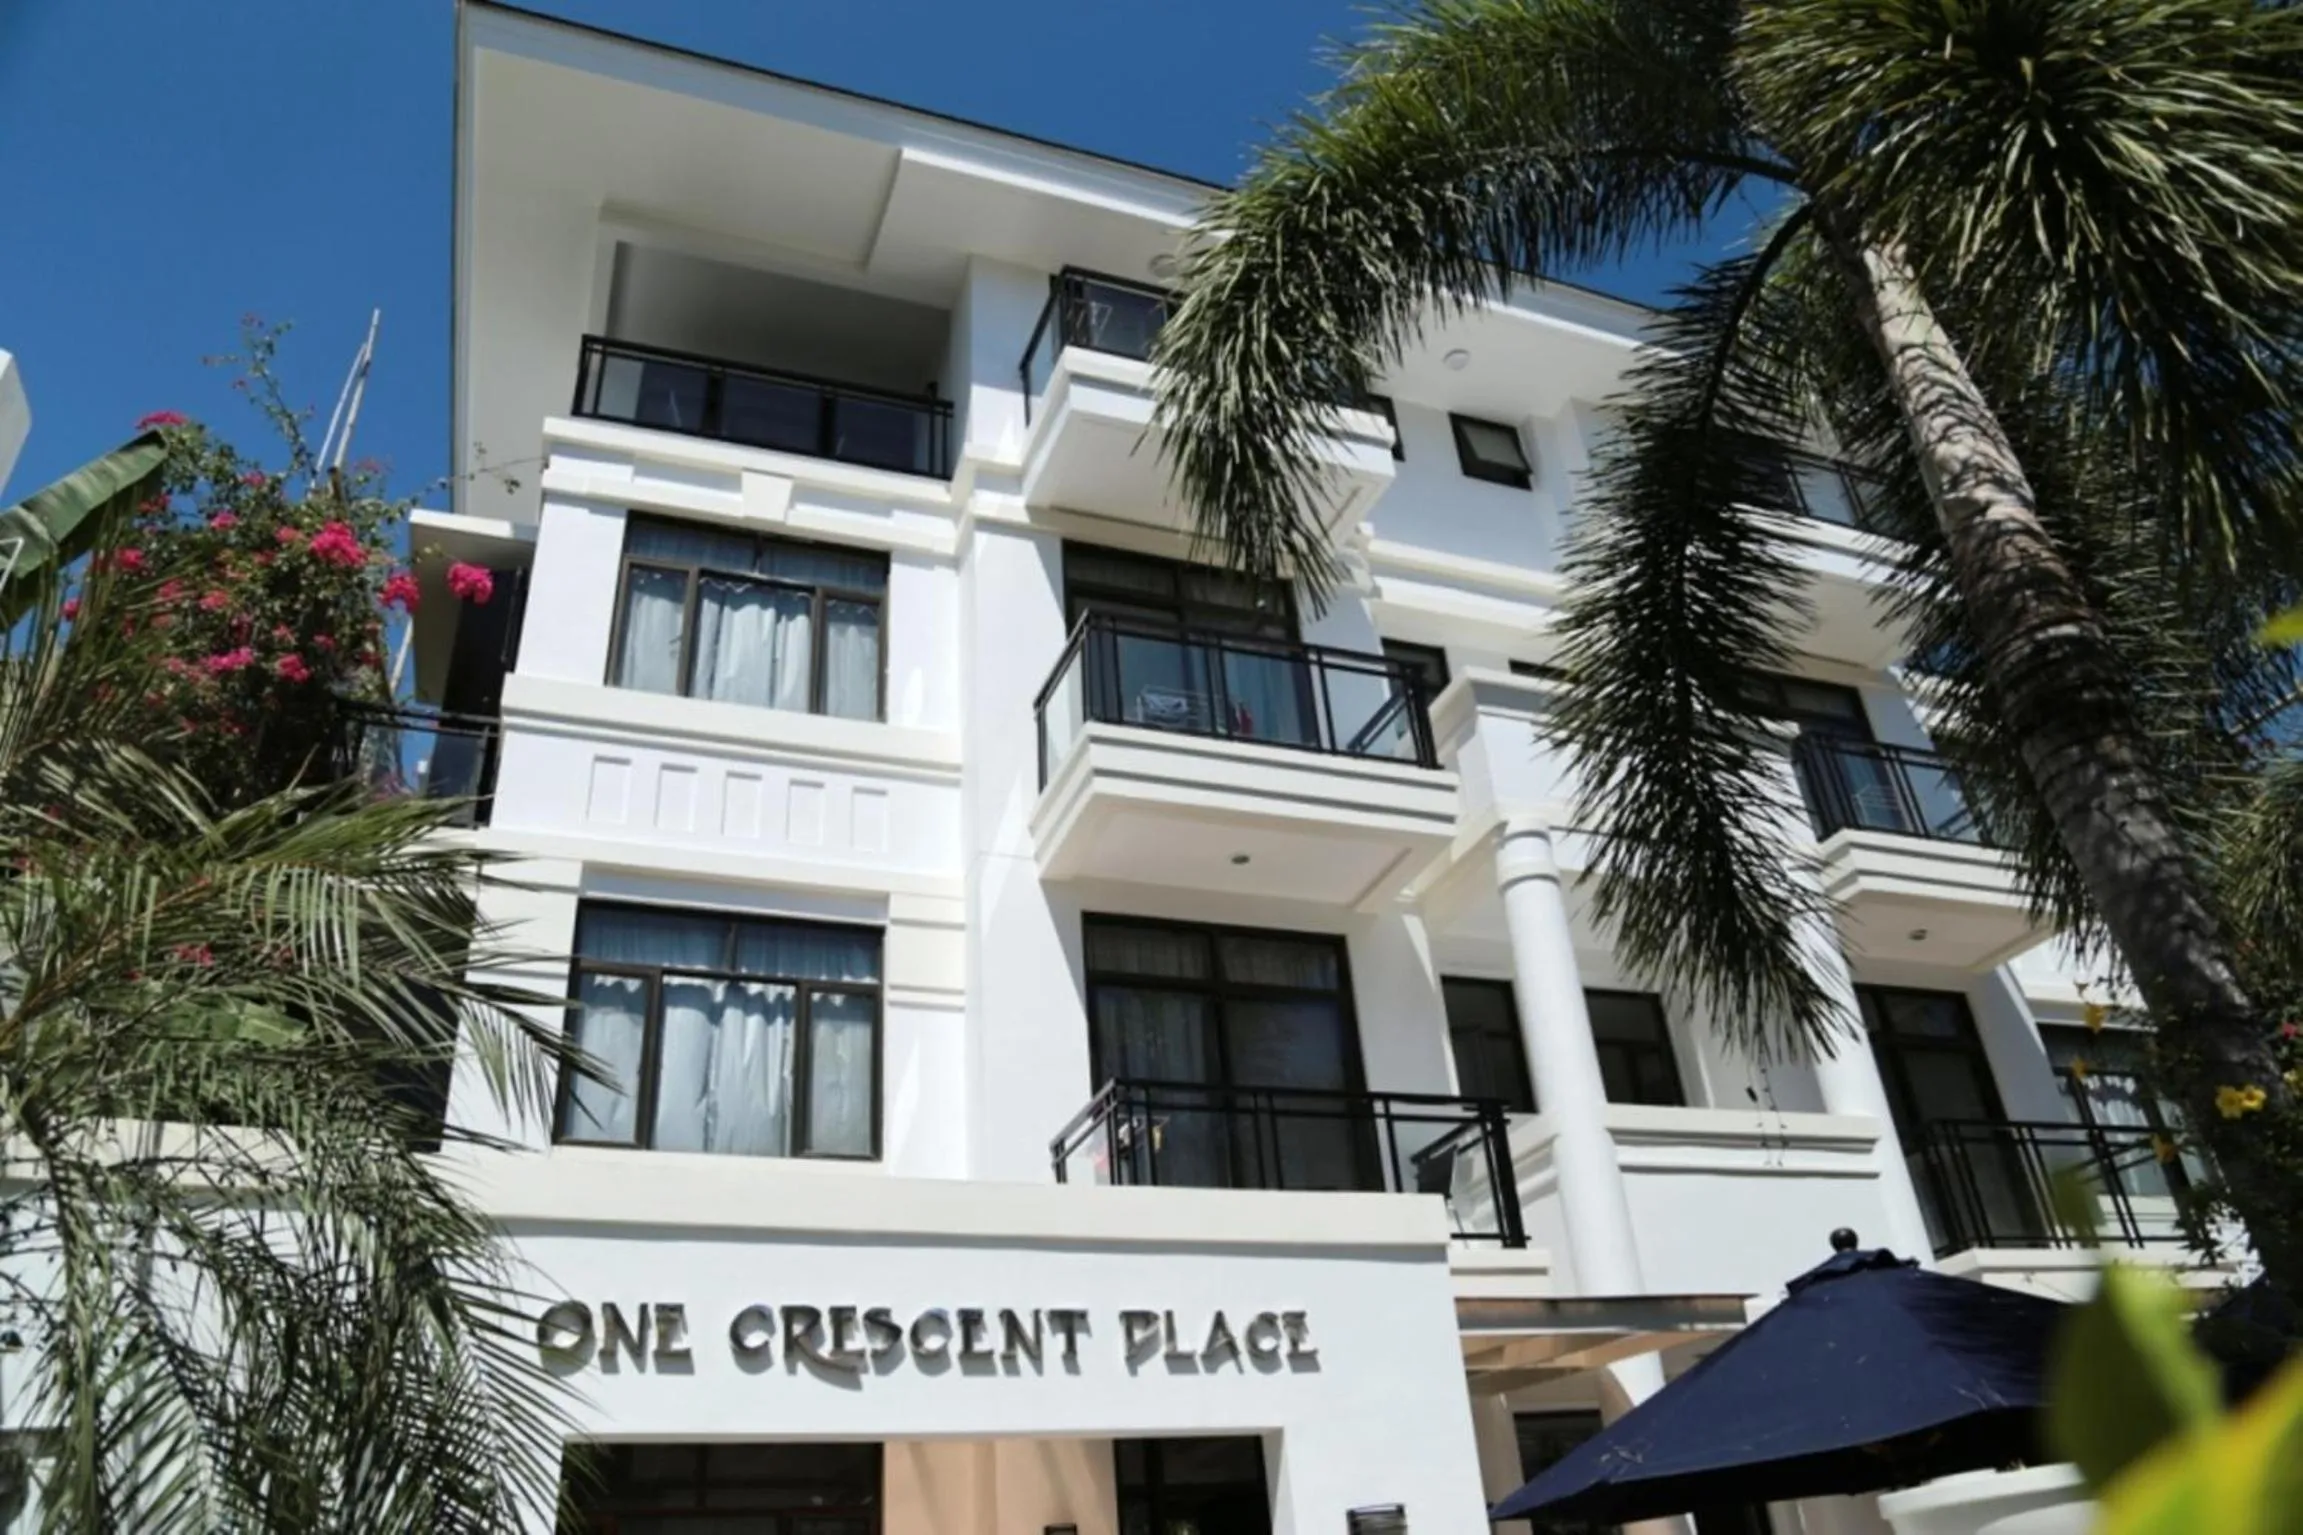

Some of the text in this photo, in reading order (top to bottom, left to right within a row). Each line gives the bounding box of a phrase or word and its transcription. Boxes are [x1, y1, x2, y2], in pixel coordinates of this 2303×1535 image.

[537, 1300, 1319, 1376] ONE CRESCENT PLACE
